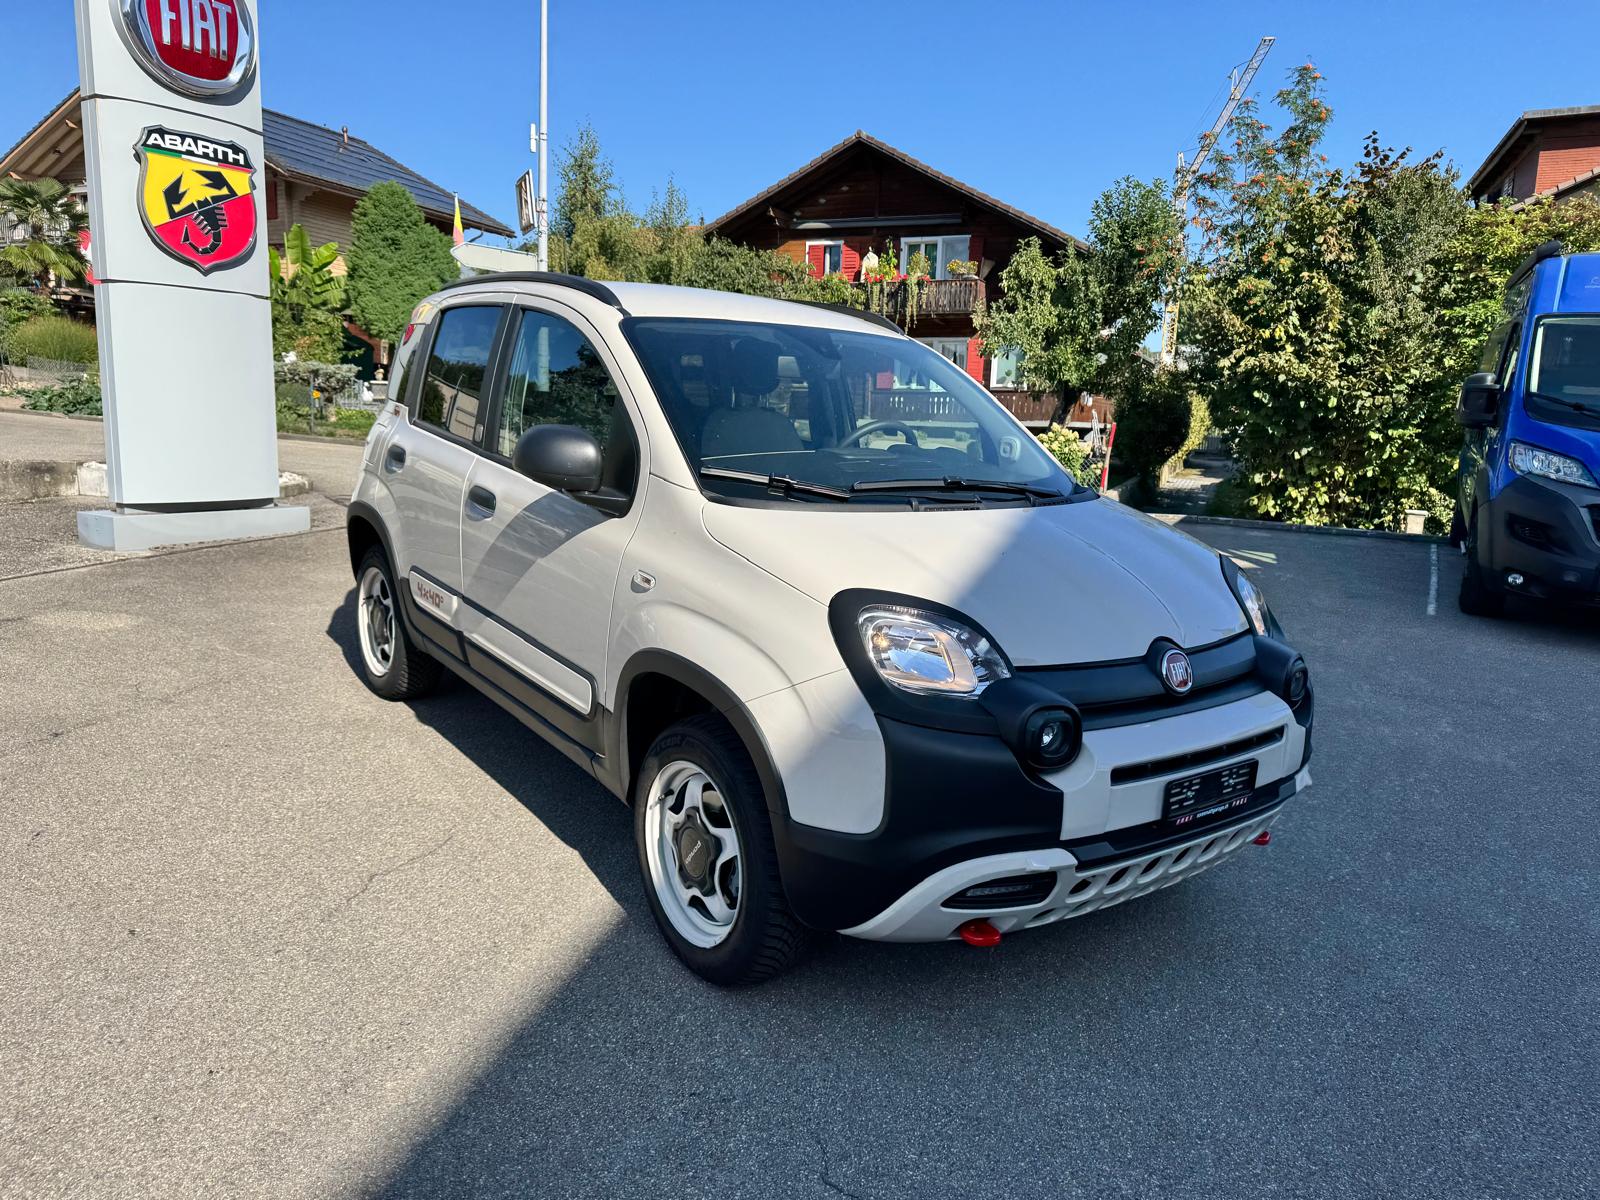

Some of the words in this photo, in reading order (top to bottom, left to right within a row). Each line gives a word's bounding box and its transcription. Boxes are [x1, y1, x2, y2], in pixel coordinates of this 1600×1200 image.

[160, 0, 232, 61] FIAT
[146, 133, 245, 165] ABARTH
[1170, 661, 1188, 682] FIAT
